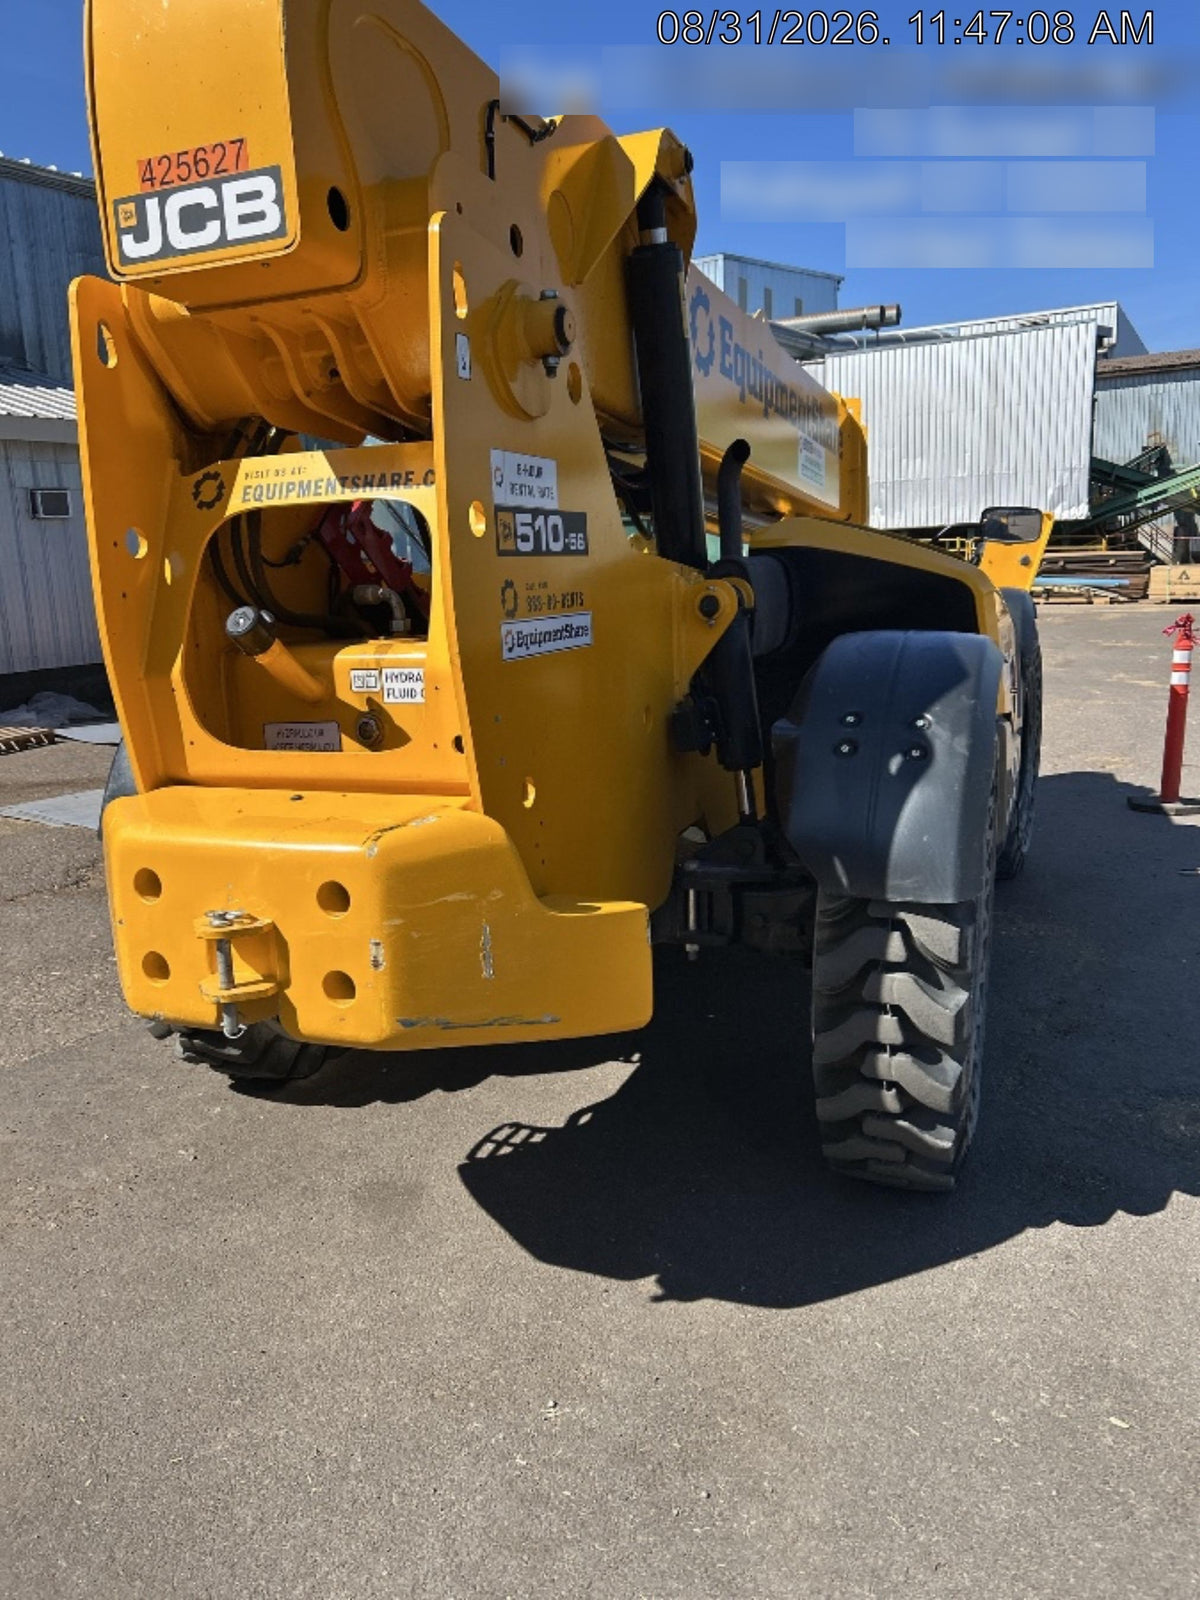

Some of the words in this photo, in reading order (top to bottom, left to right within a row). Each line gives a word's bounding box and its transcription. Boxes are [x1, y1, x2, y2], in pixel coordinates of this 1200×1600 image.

[141, 138, 244, 187] 425627
[121, 175, 281, 258] JCB
[386, 687, 417, 699] FLUID
